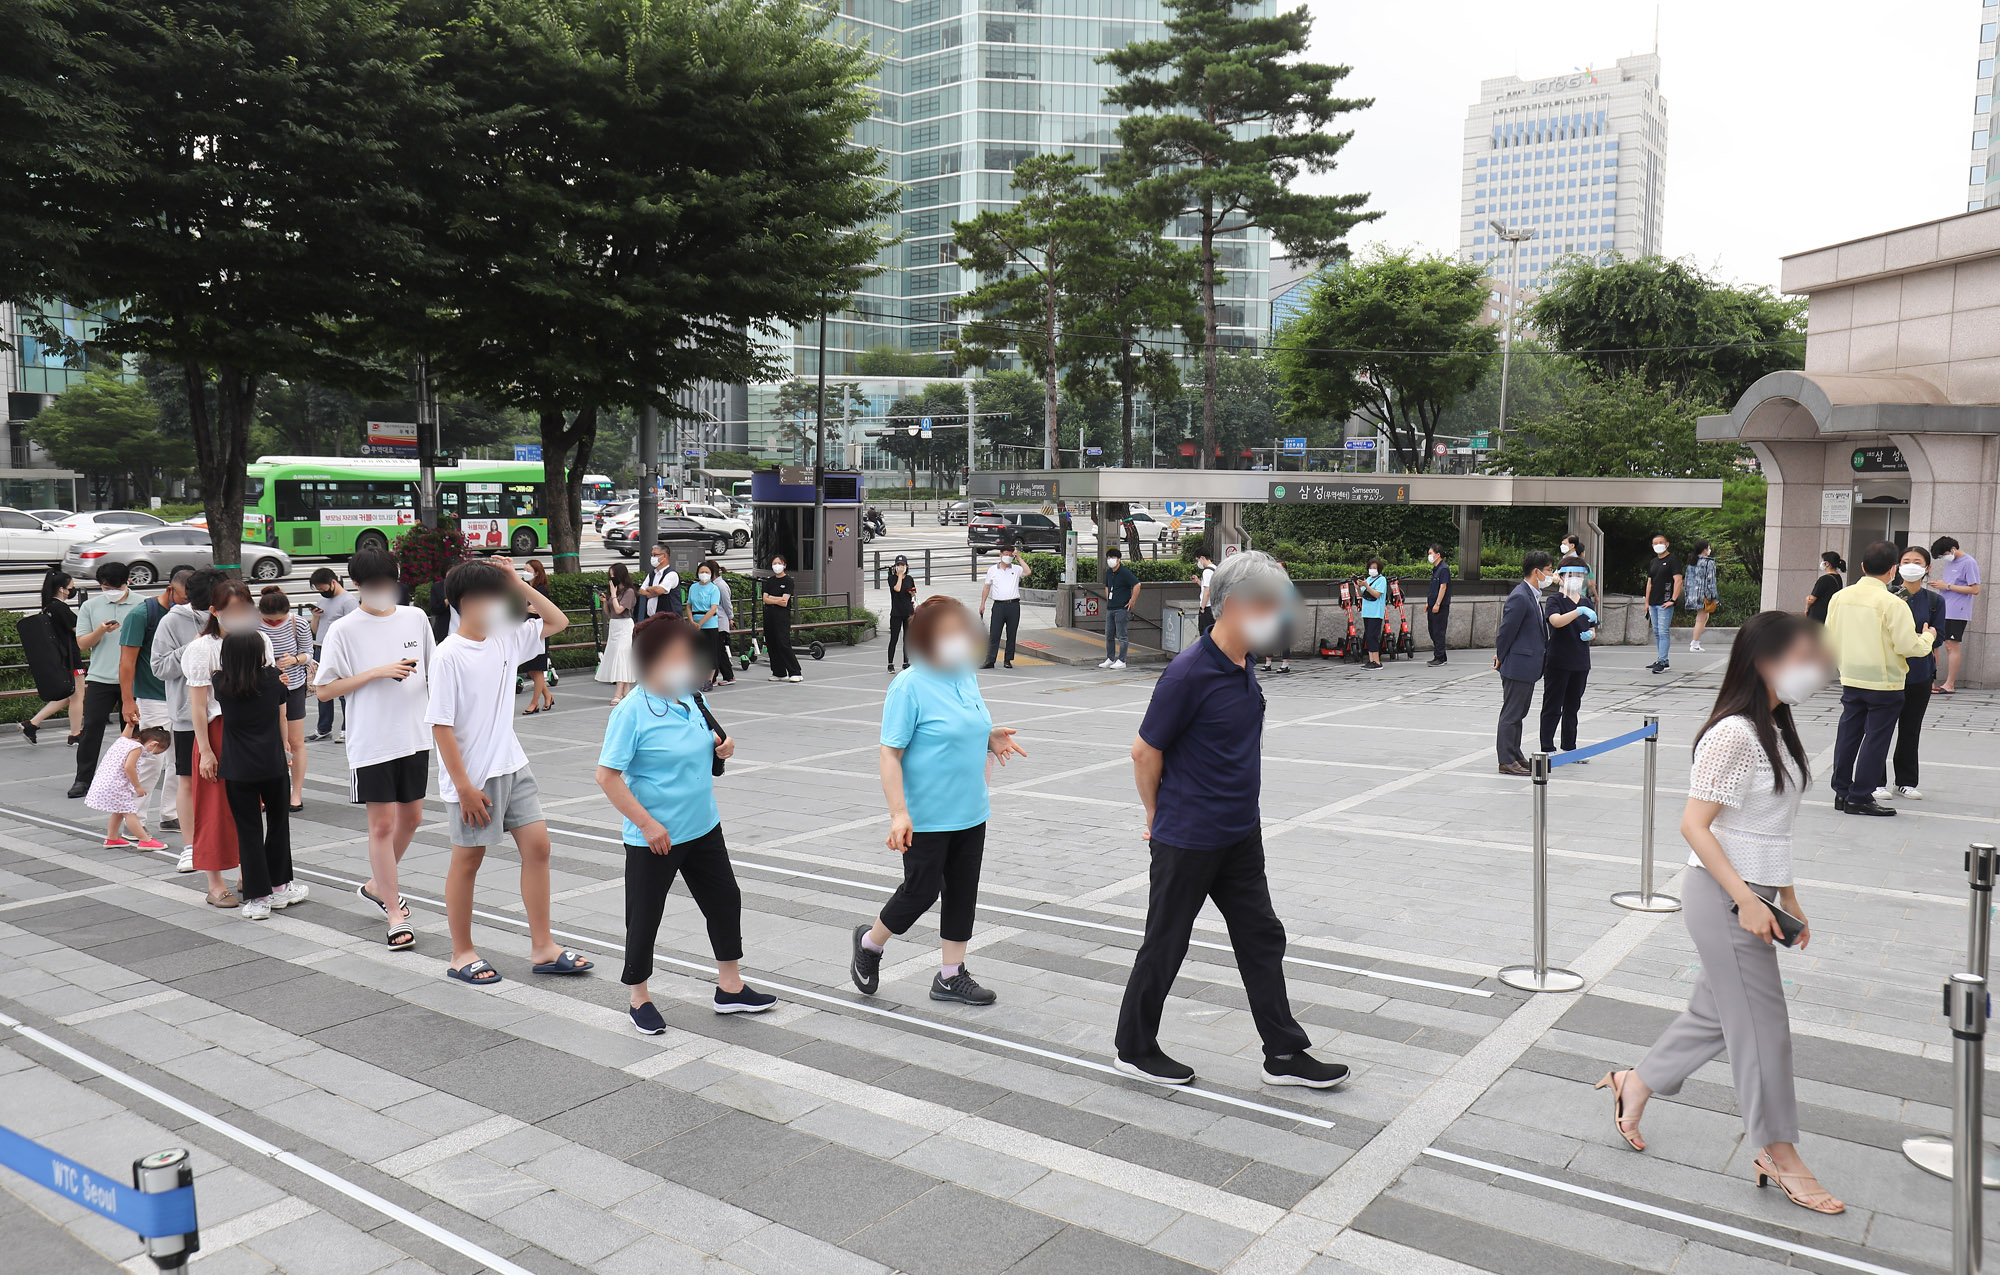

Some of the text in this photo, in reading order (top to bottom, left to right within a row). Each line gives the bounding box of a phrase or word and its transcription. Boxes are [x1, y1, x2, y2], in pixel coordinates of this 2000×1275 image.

[1352, 486, 1380, 495] Samseong
[1398, 486, 1404, 496] 6
[52, 1159, 117, 1214] WTC Seoul
